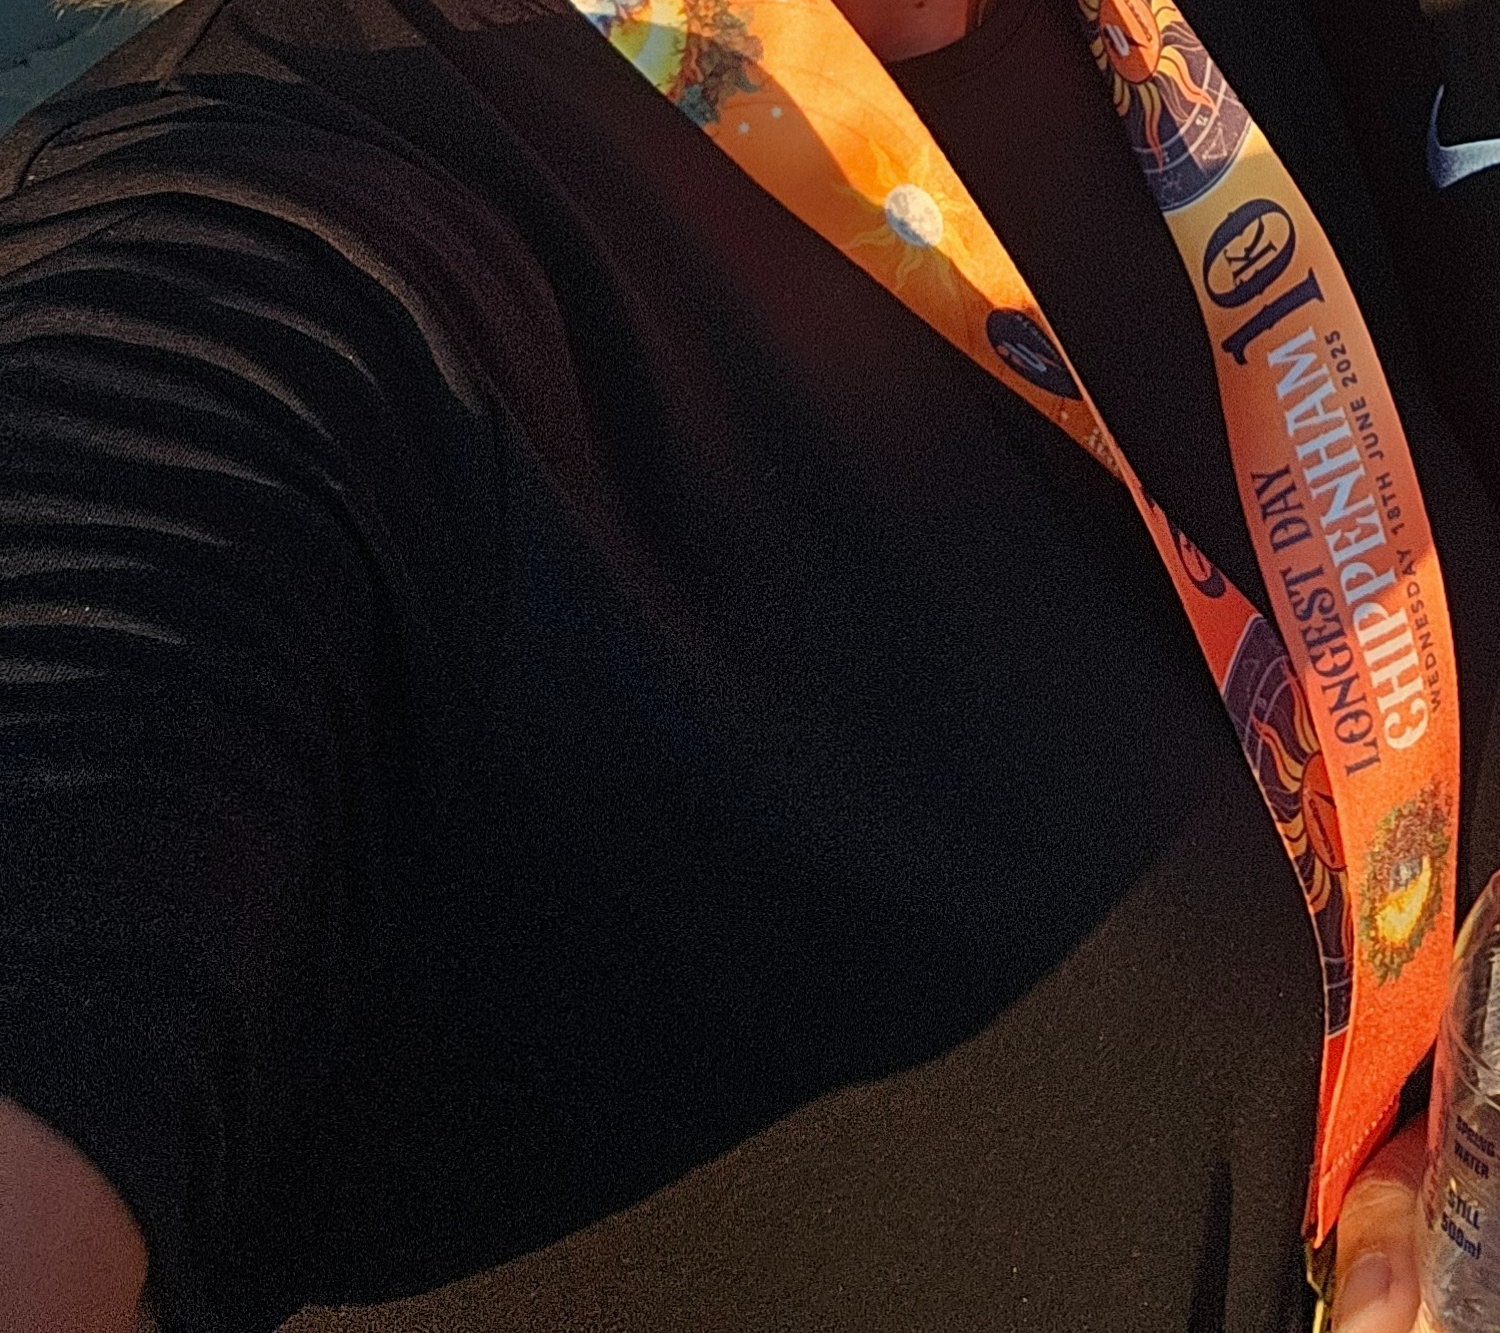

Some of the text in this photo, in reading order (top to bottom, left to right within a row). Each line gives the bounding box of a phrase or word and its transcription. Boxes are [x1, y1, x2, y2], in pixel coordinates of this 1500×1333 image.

[1251, 463, 1381, 777] LONGEST DAY
[1267, 326, 1430, 751] CHIPPENHAM
[1324, 330, 1440, 712] WEDNESDAY 18TH JUNE 2025
[1441, 1211, 1481, 1260] 500ml
[1448, 1188, 1480, 1230] STILL
